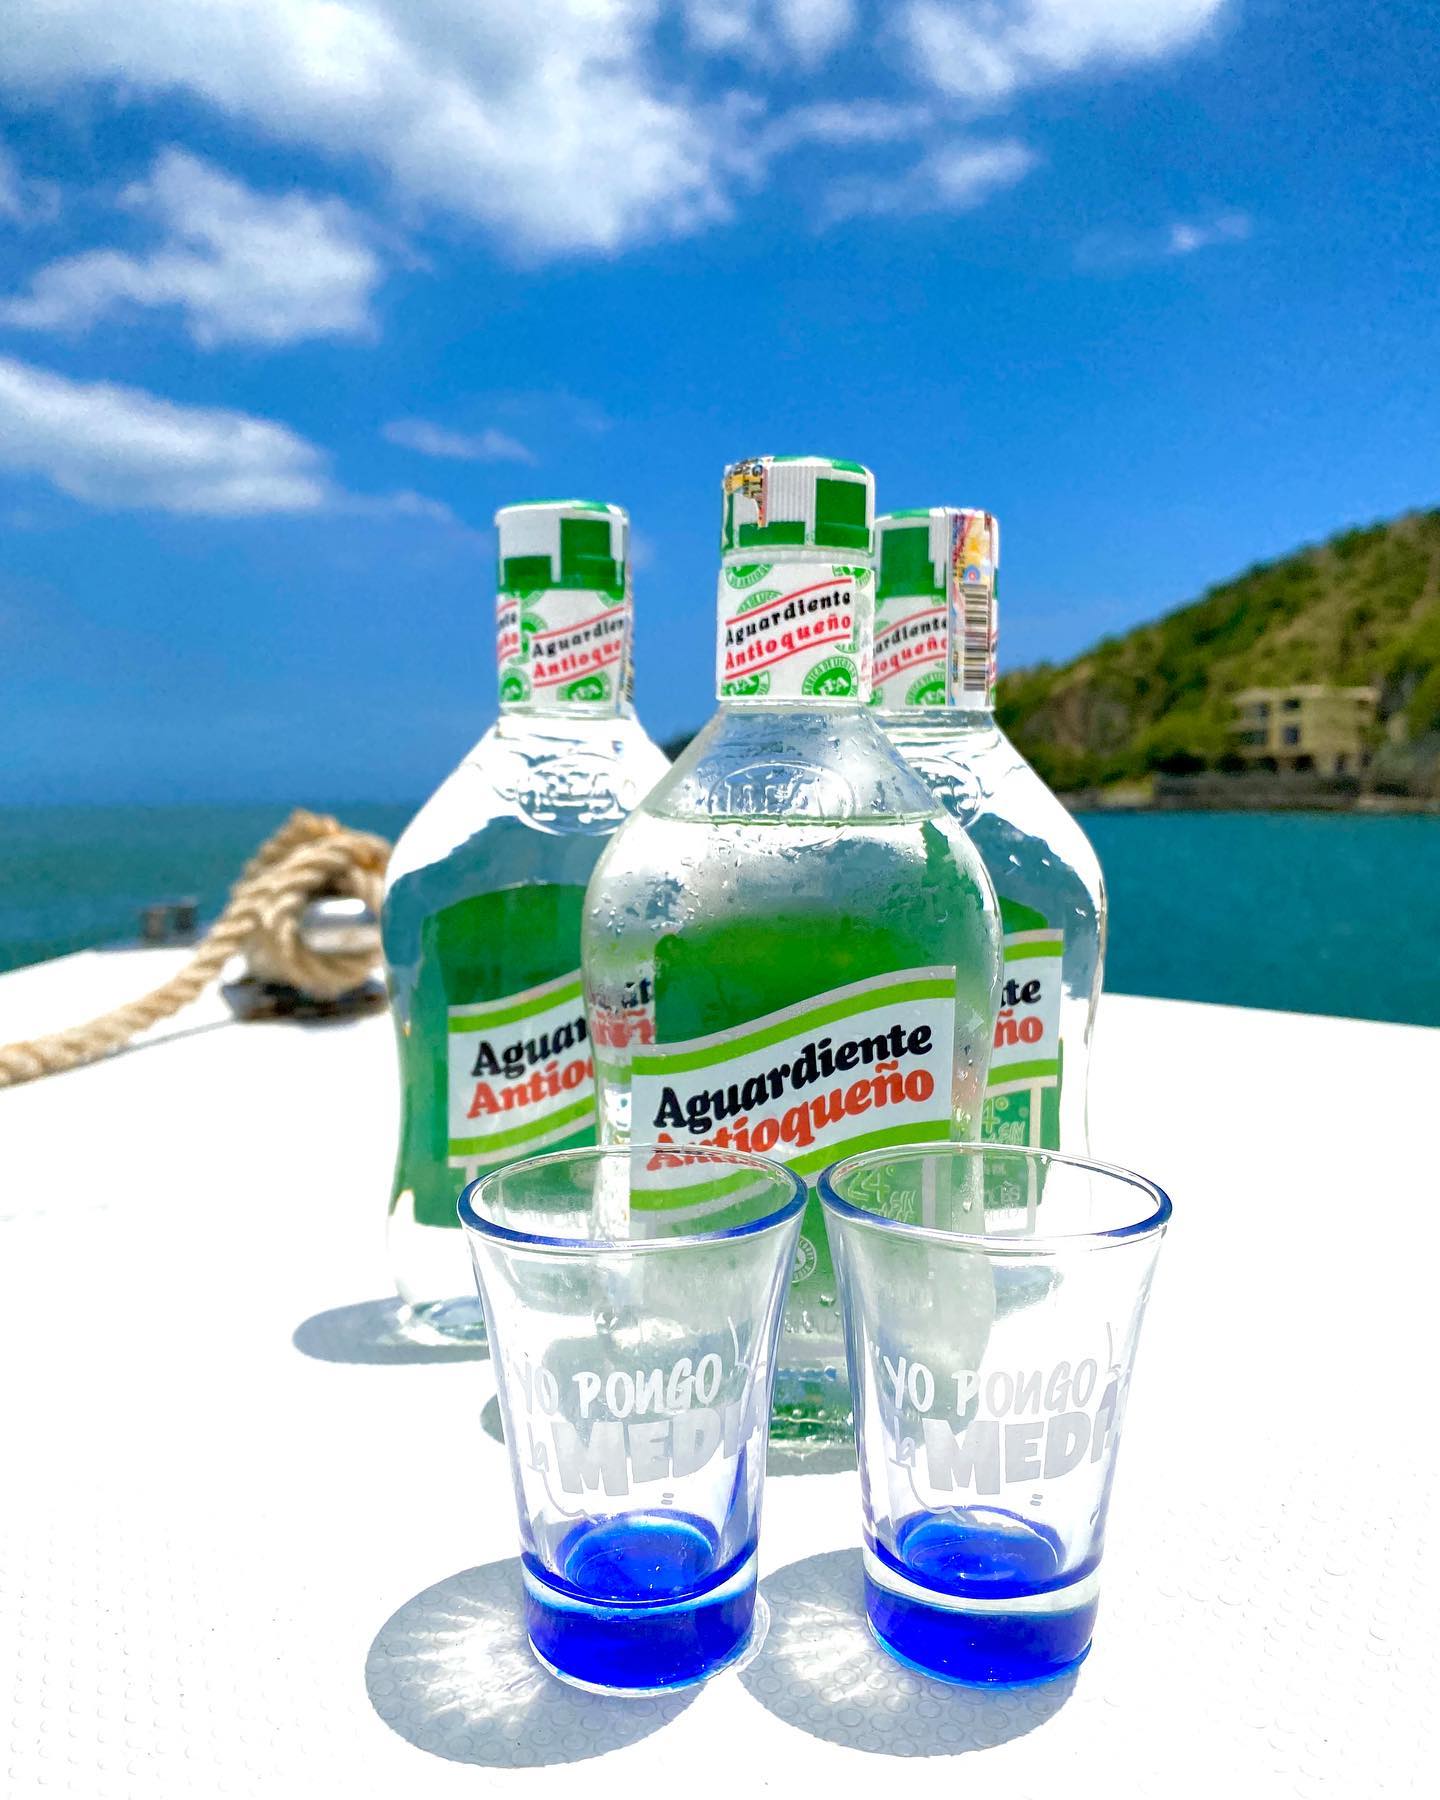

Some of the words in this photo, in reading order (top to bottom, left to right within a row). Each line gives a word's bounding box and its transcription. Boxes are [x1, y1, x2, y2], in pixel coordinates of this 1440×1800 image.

[725, 591, 851, 648] Aguardiente
[725, 614, 851, 671] Antioqueño
[1001, 979, 1041, 1007] te
[994, 1008, 1043, 1049] ño
[653, 1024, 932, 1134] Aguardiente
[647, 1060, 935, 1171] Antioqueño
[572, 1353, 722, 1418] PONGO
[952, 1358, 1098, 1418] PONGO
